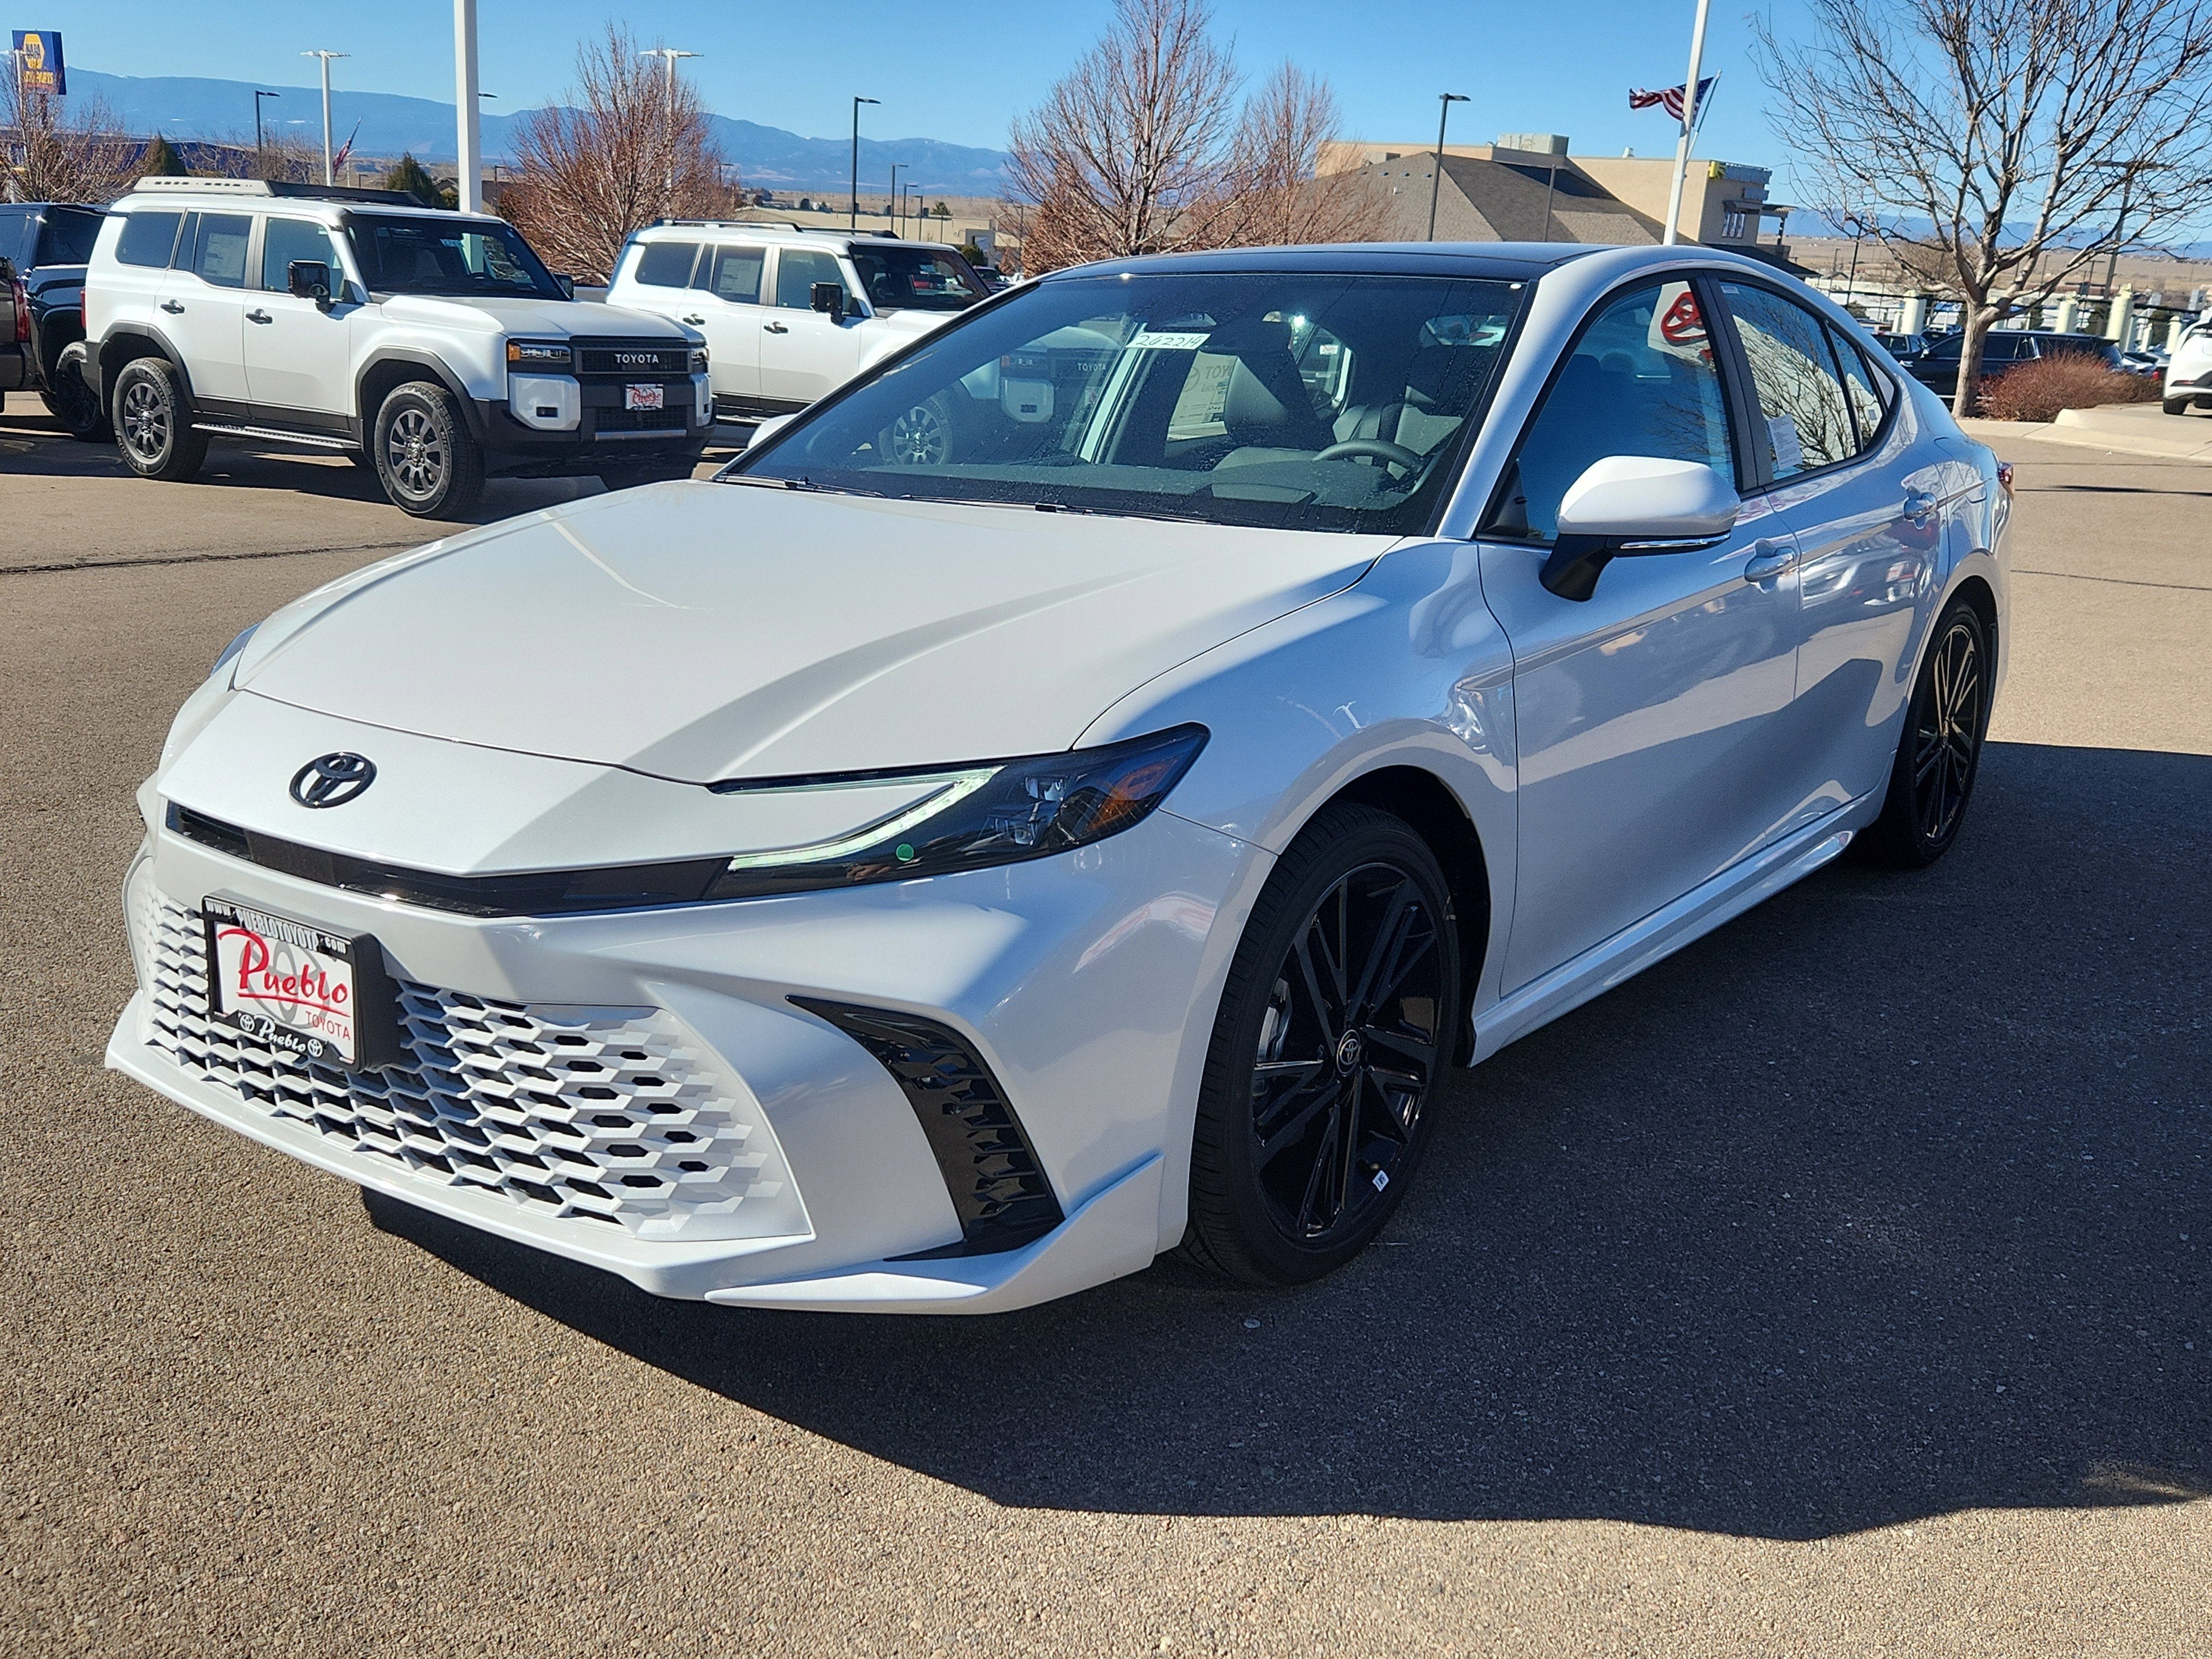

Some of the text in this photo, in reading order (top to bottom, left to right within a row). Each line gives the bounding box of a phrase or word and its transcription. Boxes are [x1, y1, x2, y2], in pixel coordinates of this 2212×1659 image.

[614, 353, 659, 364] TOYOTA
[1077, 363, 1107, 371] TOYOTA
[217, 928, 348, 1004] Pueblo
[254, 1014, 306, 1052] Pueblo
[305, 1011, 351, 1041] TOYOTA
